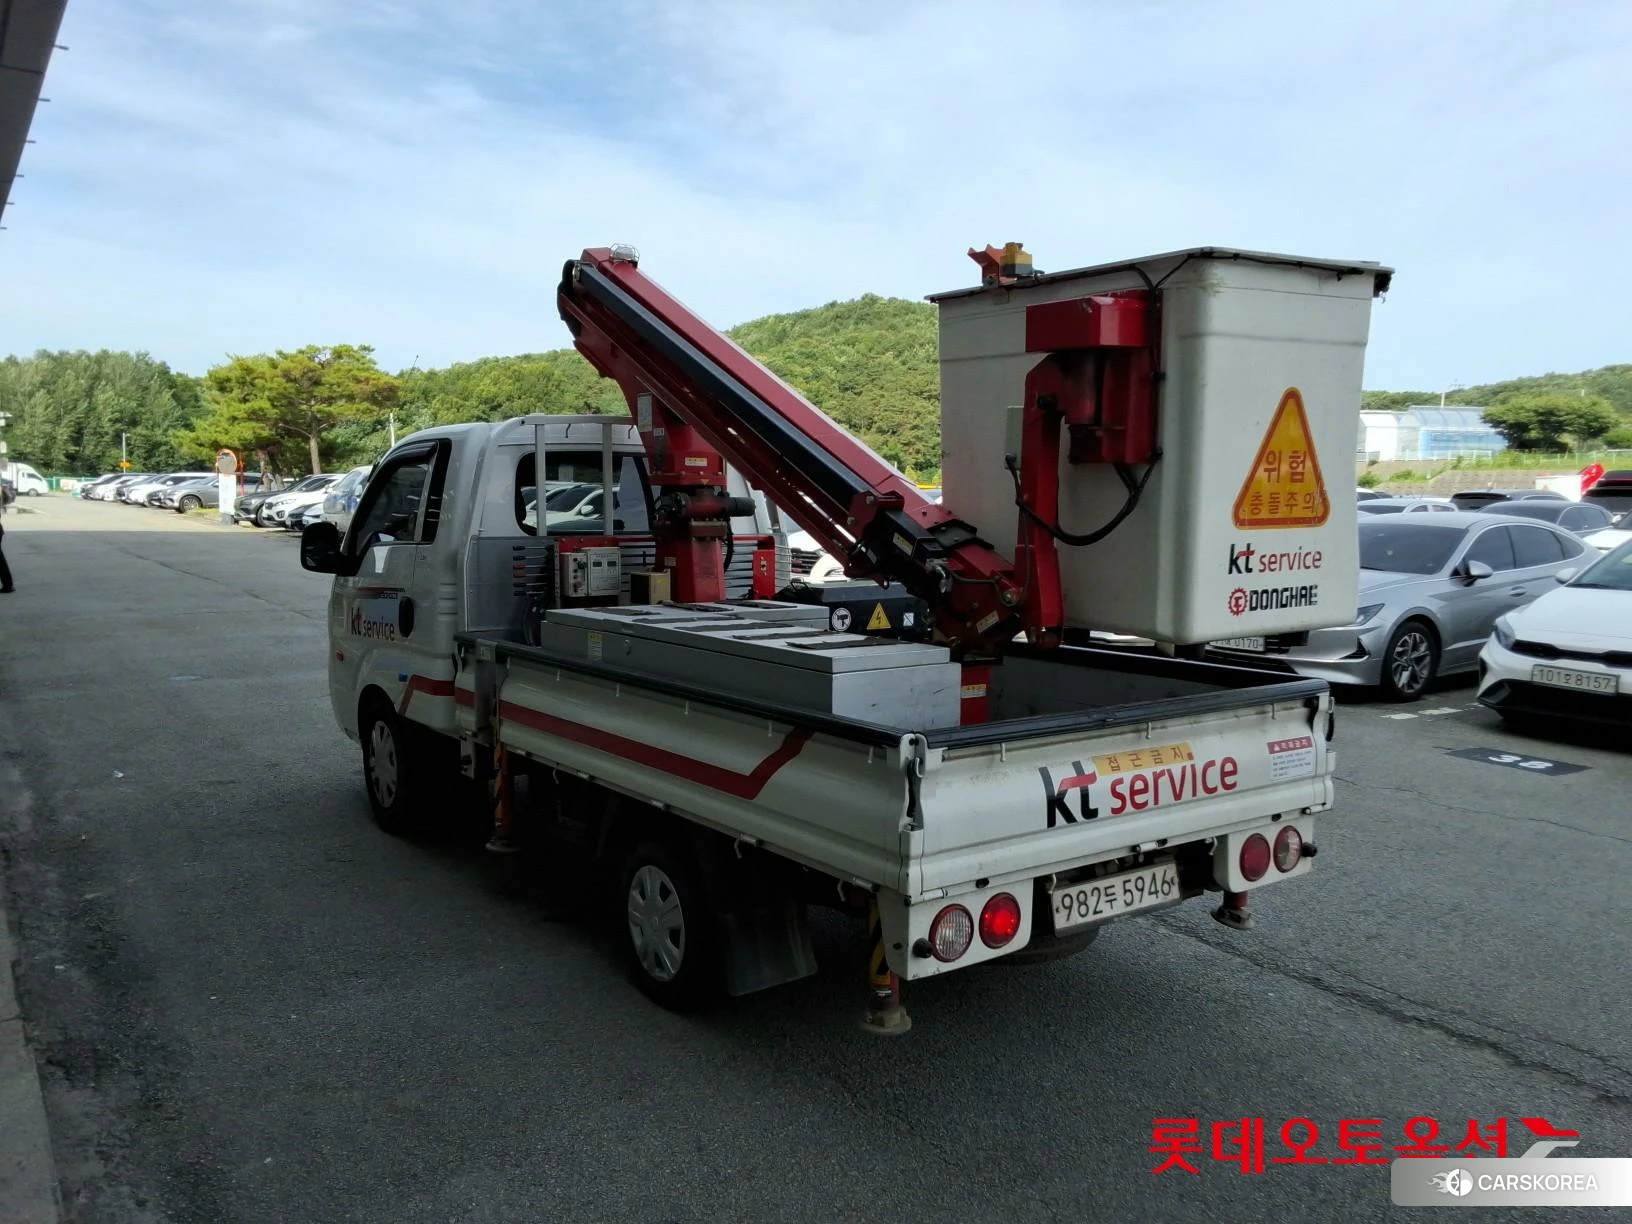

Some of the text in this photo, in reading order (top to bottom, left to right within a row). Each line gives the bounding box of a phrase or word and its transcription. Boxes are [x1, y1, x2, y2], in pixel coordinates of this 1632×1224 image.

[1264, 450, 1307, 483] 위험
[1249, 491, 1315, 515] 충돌주의
[1228, 543, 1322, 575] kt service
[1249, 585, 1318, 611] DONGHAE
[351, 607, 395, 641] kt service
[1106, 747, 1184, 772] 접근금지
[1038, 752, 1238, 829] kt service
